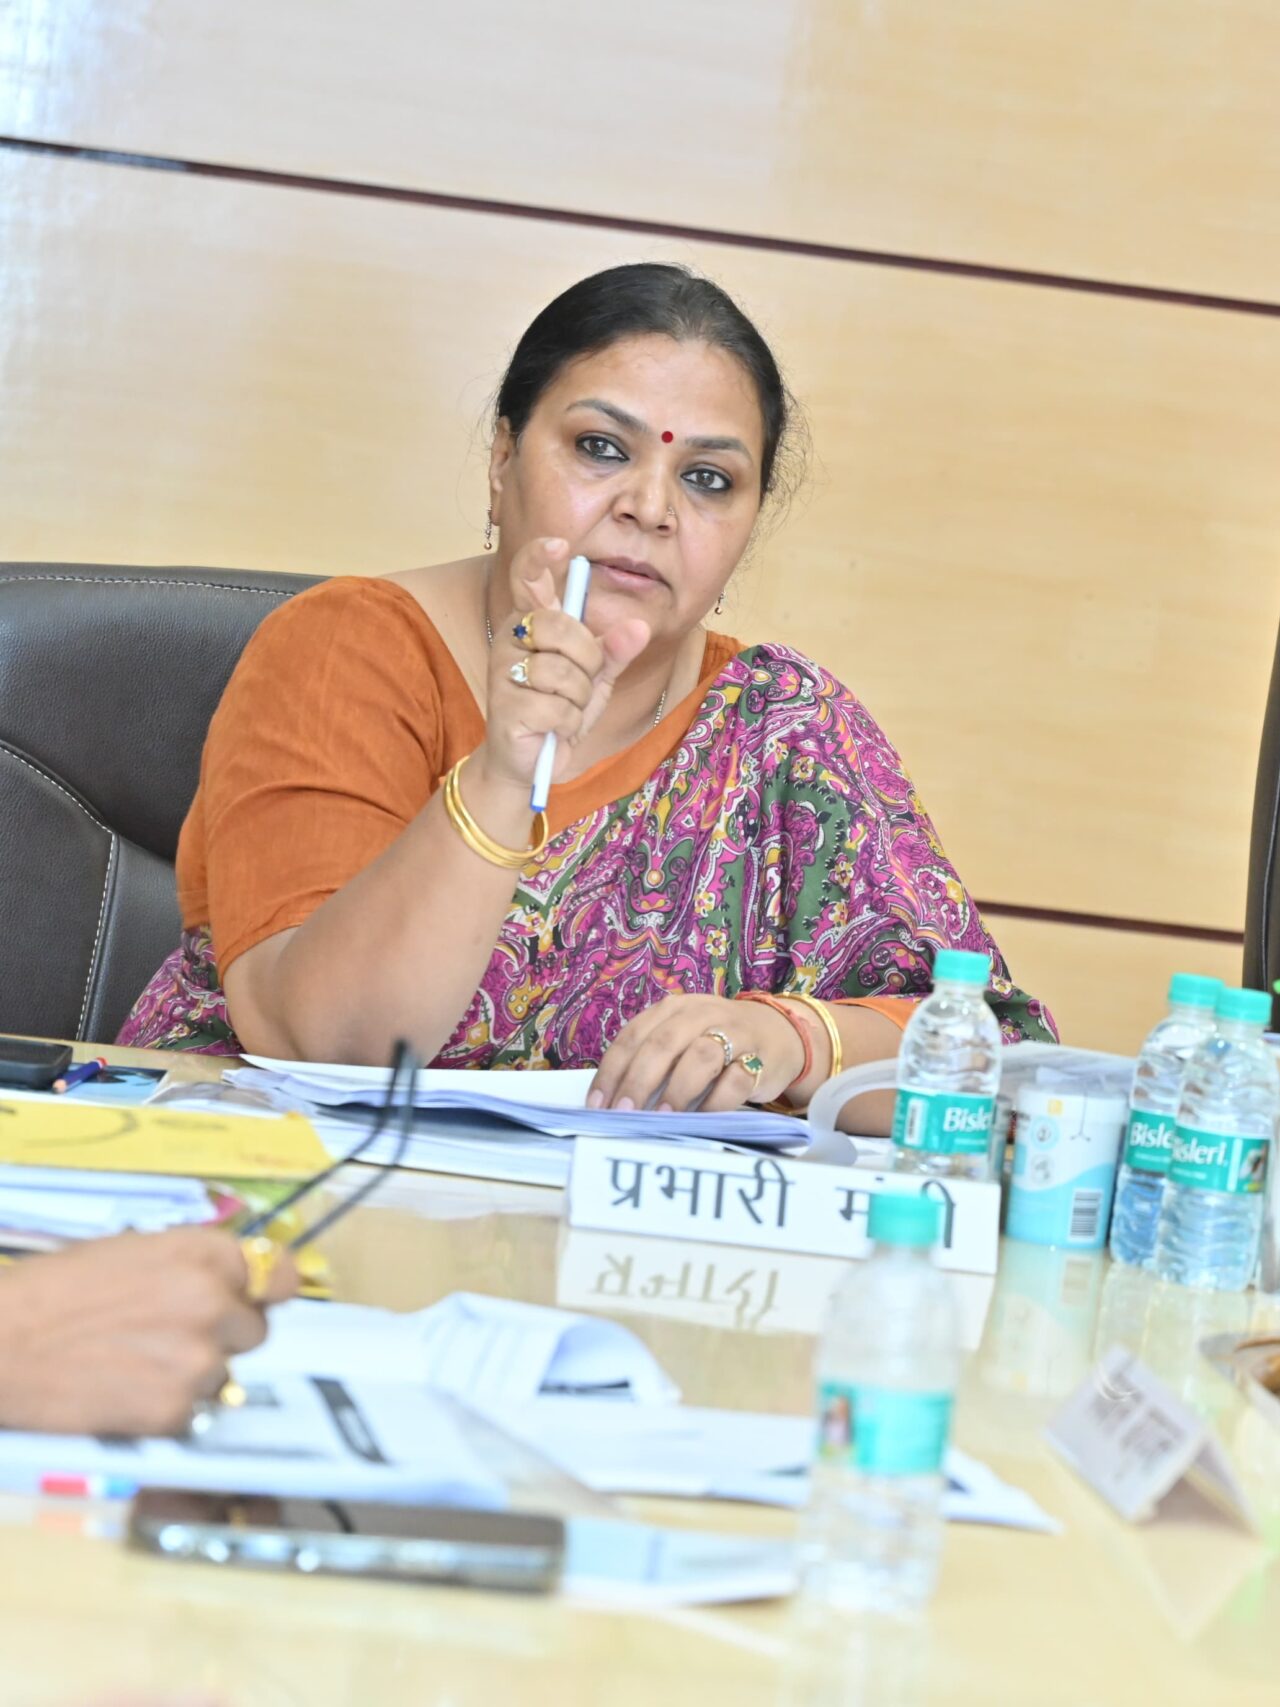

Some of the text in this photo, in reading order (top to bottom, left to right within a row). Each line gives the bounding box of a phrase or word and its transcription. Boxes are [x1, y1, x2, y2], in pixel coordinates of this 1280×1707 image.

[943, 1106, 993, 1133] Bisle
[1129, 1122, 1174, 1150] Bisle
[606, 1157, 796, 1229] प्रभारी
